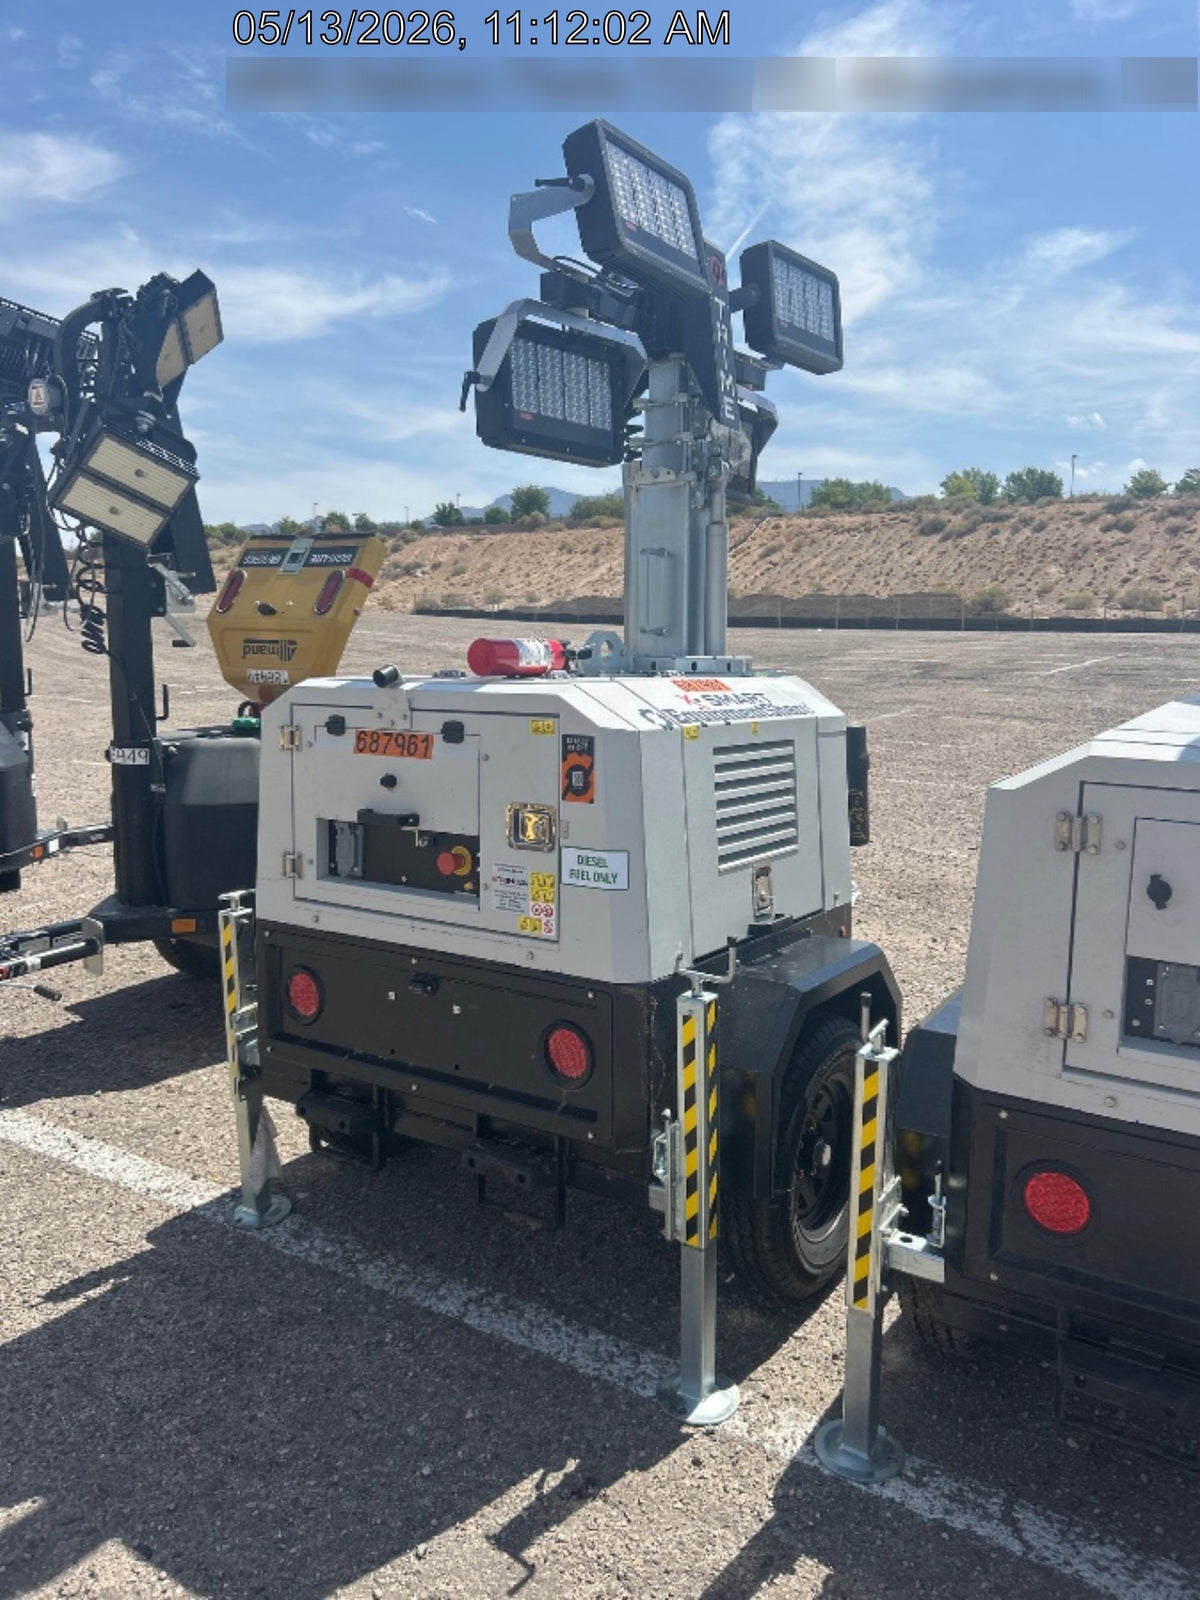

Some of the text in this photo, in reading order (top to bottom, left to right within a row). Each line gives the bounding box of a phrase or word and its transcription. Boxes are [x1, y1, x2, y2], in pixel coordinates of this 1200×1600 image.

[242, 640, 298, 662] Allmand
[355, 730, 432, 758] 687961
[577, 854, 608, 868] DIESEL
[569, 868, 618, 885] FUEL ONLY
